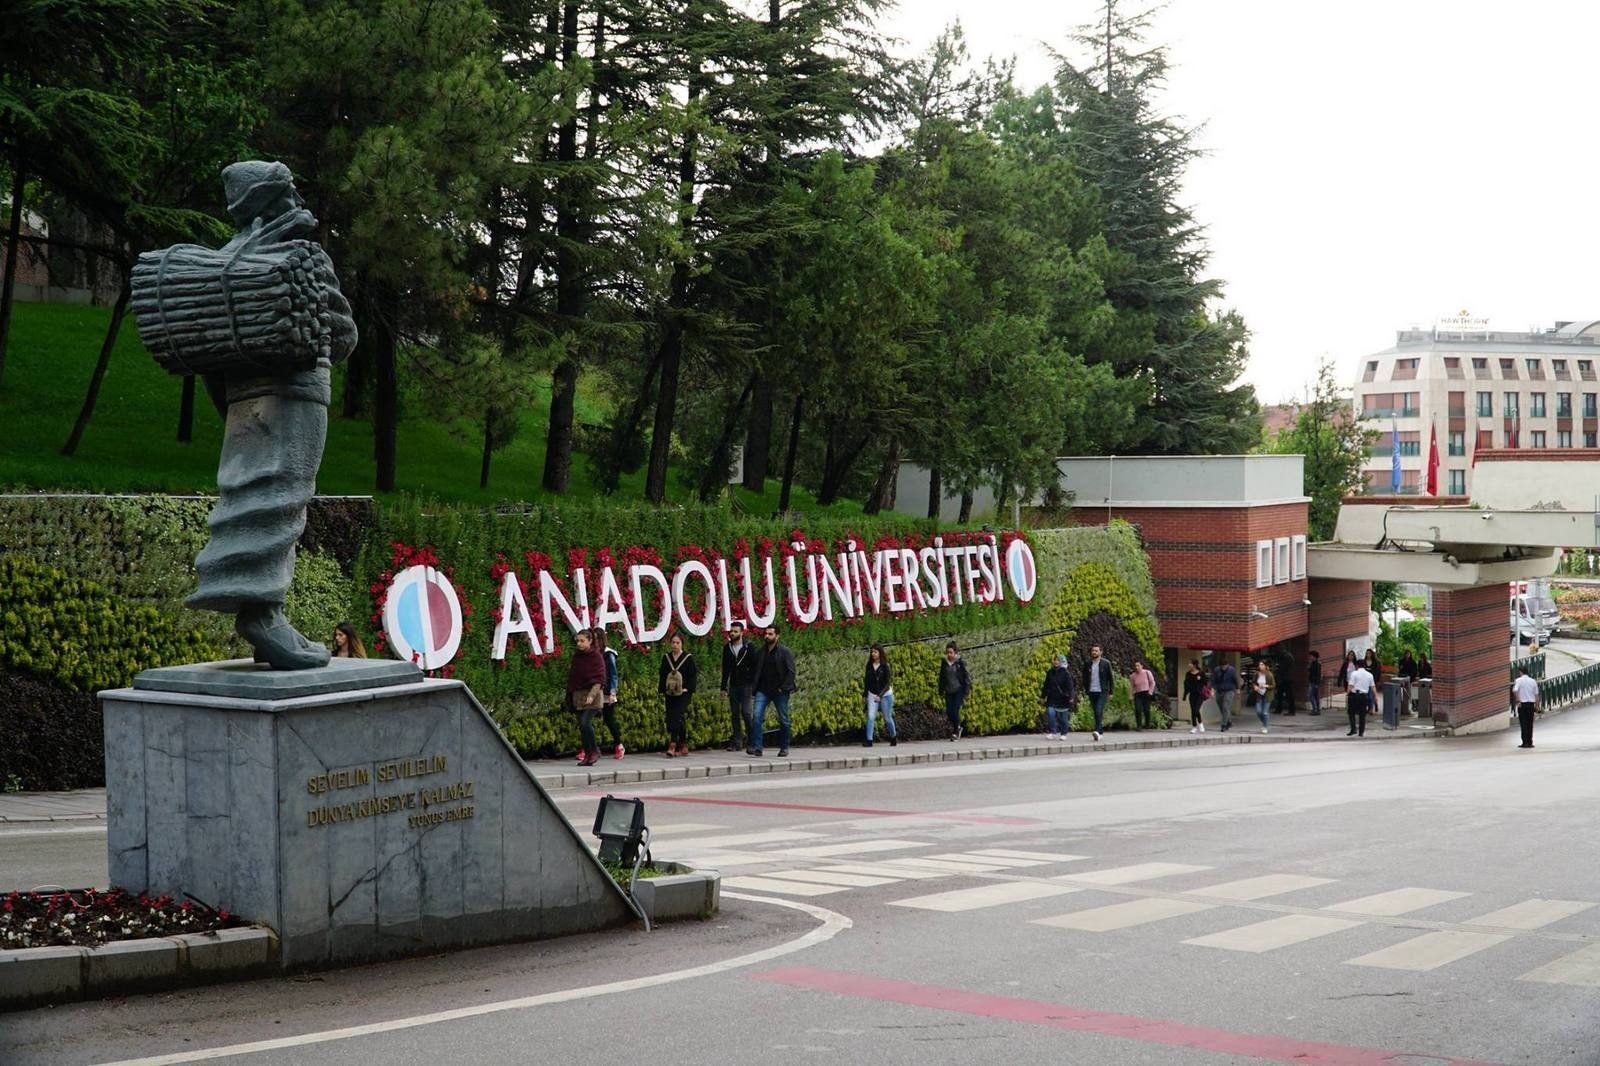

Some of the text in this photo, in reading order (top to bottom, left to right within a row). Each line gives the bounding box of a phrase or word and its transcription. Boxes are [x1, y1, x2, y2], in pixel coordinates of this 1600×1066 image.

[1441, 317, 1490, 325] HAWTHRN
[491, 534, 1004, 660] ANADOLU ÜNİVERSİTESİ
[420, 781, 474, 807] KALMAZ
[408, 805, 474, 829] YUNUS EMRE
